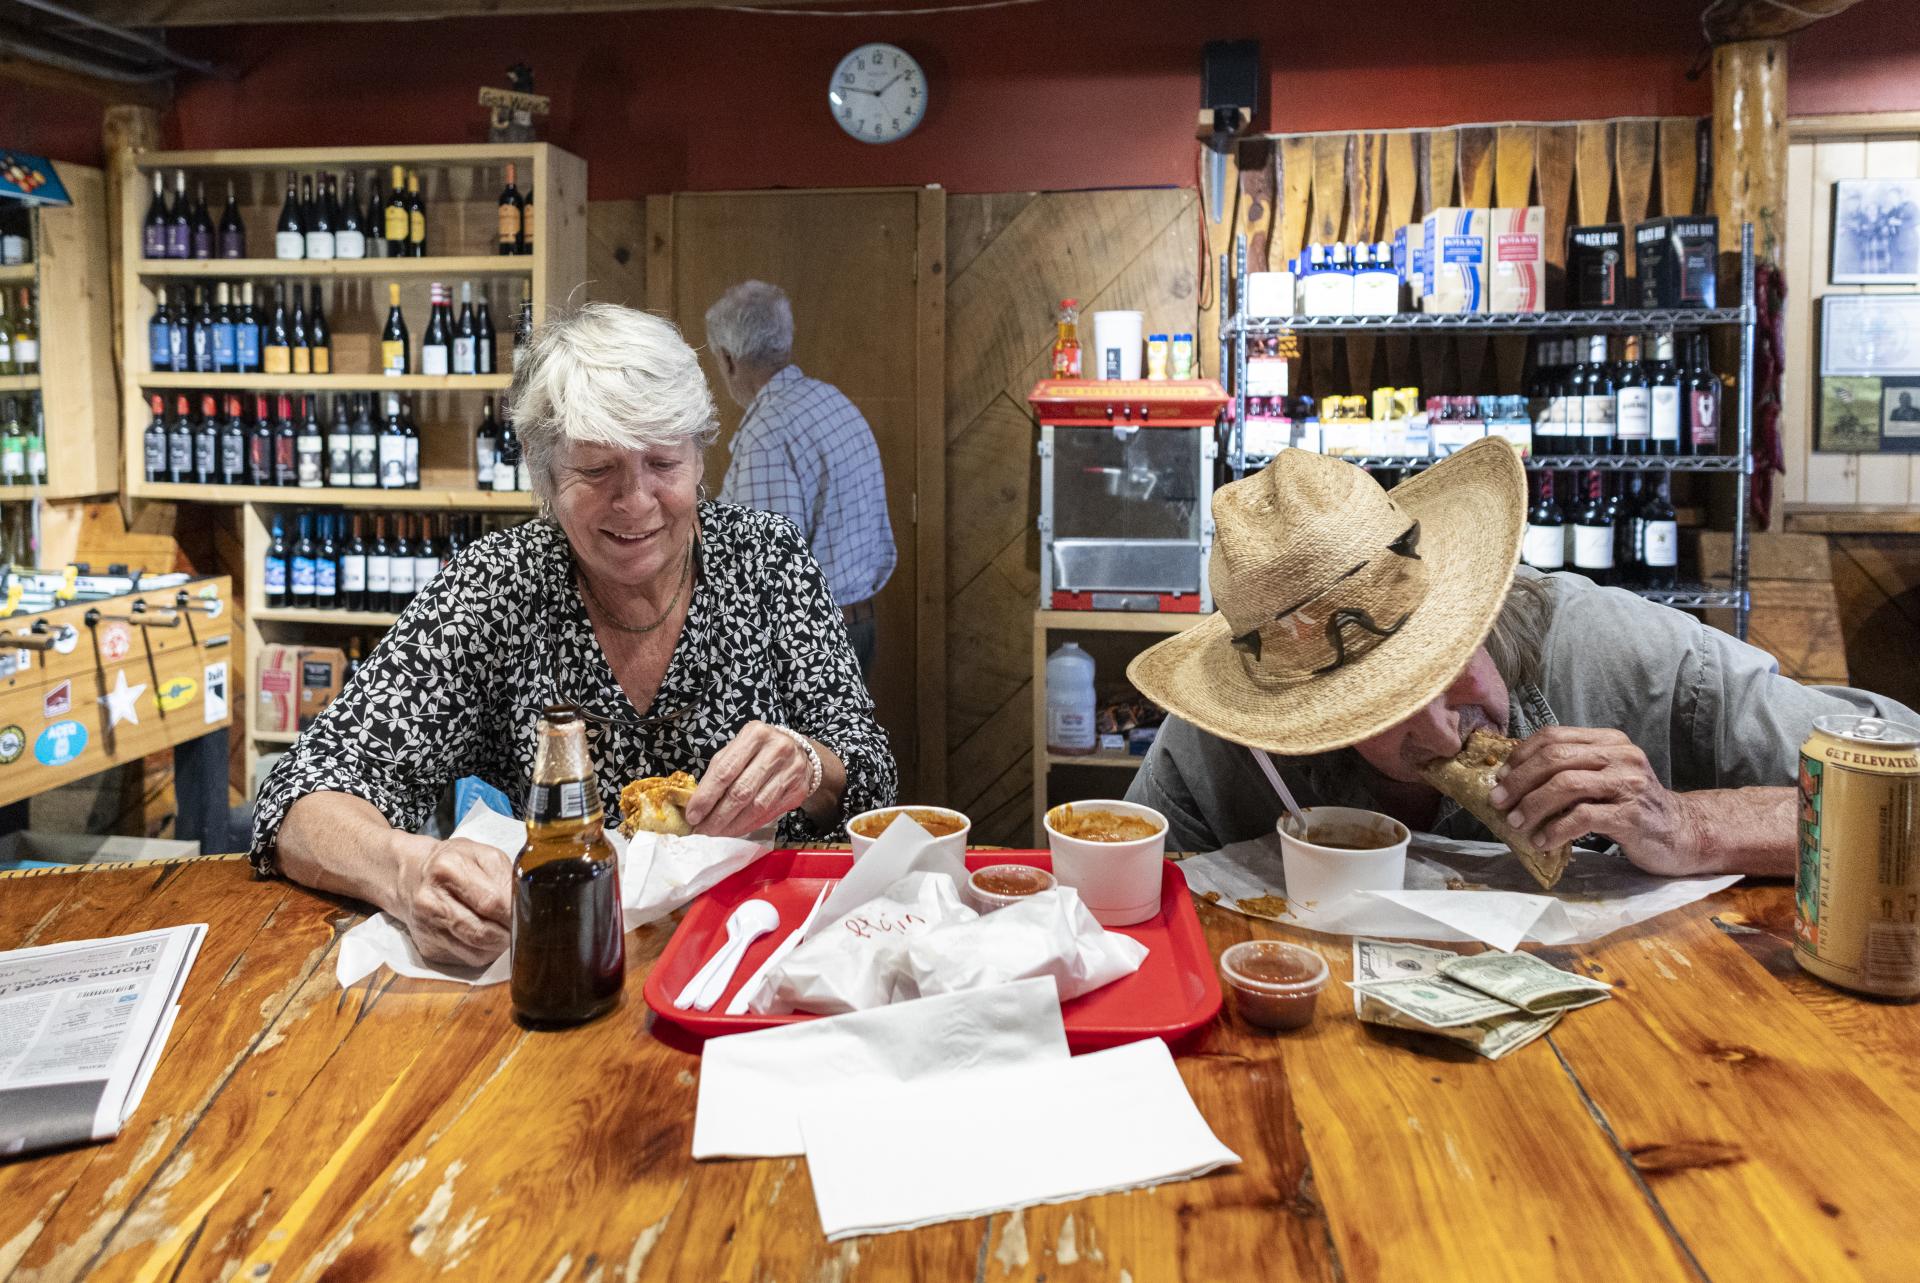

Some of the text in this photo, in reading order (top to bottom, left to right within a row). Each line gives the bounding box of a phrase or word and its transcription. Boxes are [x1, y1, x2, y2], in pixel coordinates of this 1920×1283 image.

[872, 53, 883, 65] 12
[903, 69, 913, 80] 2
[874, 123, 882, 135] 6
[892, 118, 900, 130] 5
[1677, 223, 1715, 238] BLACK BOX
[1601, 231, 1619, 246] BOX
[1825, 747, 1918, 769] GET ELEVATED
[1819, 846, 1832, 951] INDIA PALE ALE
[88, 963, 152, 979] Home
[14, 974, 82, 992] Sweet
